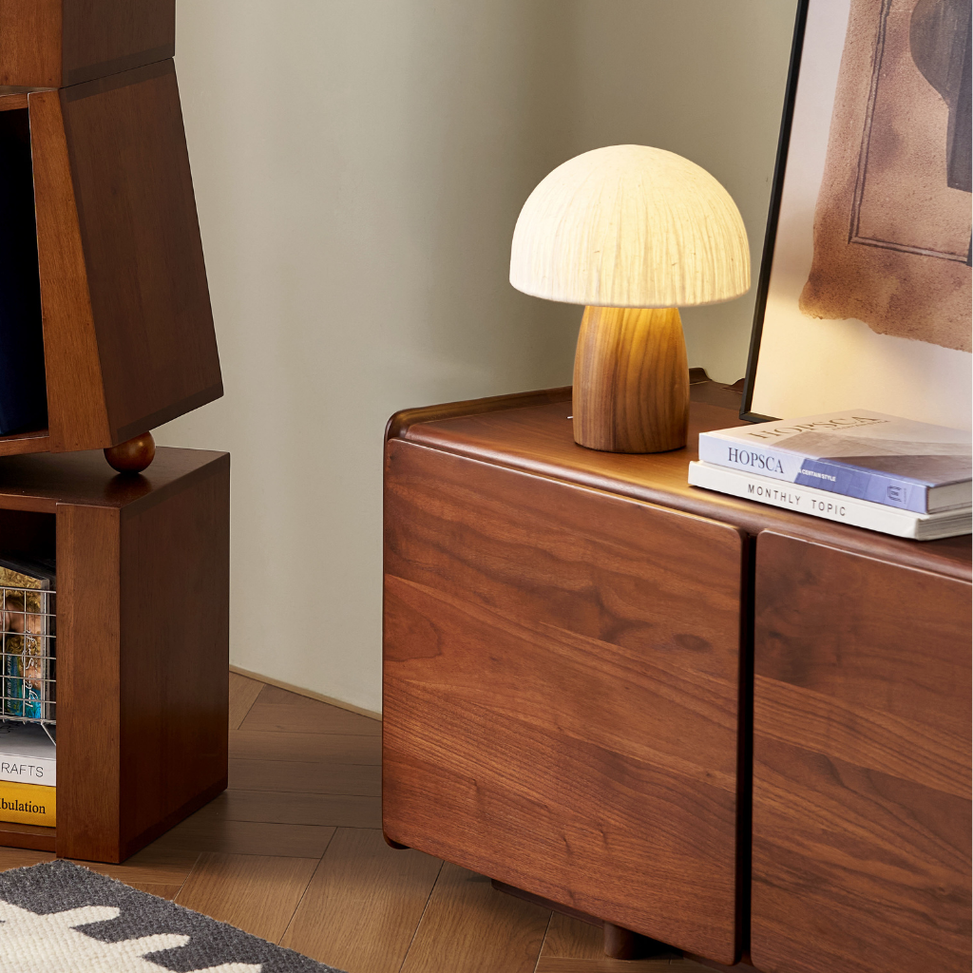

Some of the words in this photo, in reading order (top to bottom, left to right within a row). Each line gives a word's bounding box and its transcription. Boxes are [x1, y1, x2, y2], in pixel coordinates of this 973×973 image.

[748, 416, 880, 439] HOPSCA
[728, 447, 785, 474] HOPSCA
[821, 473, 836, 482] STYLE
[747, 483, 801, 506] MONTHLY
[811, 499, 847, 516] TOPIC
